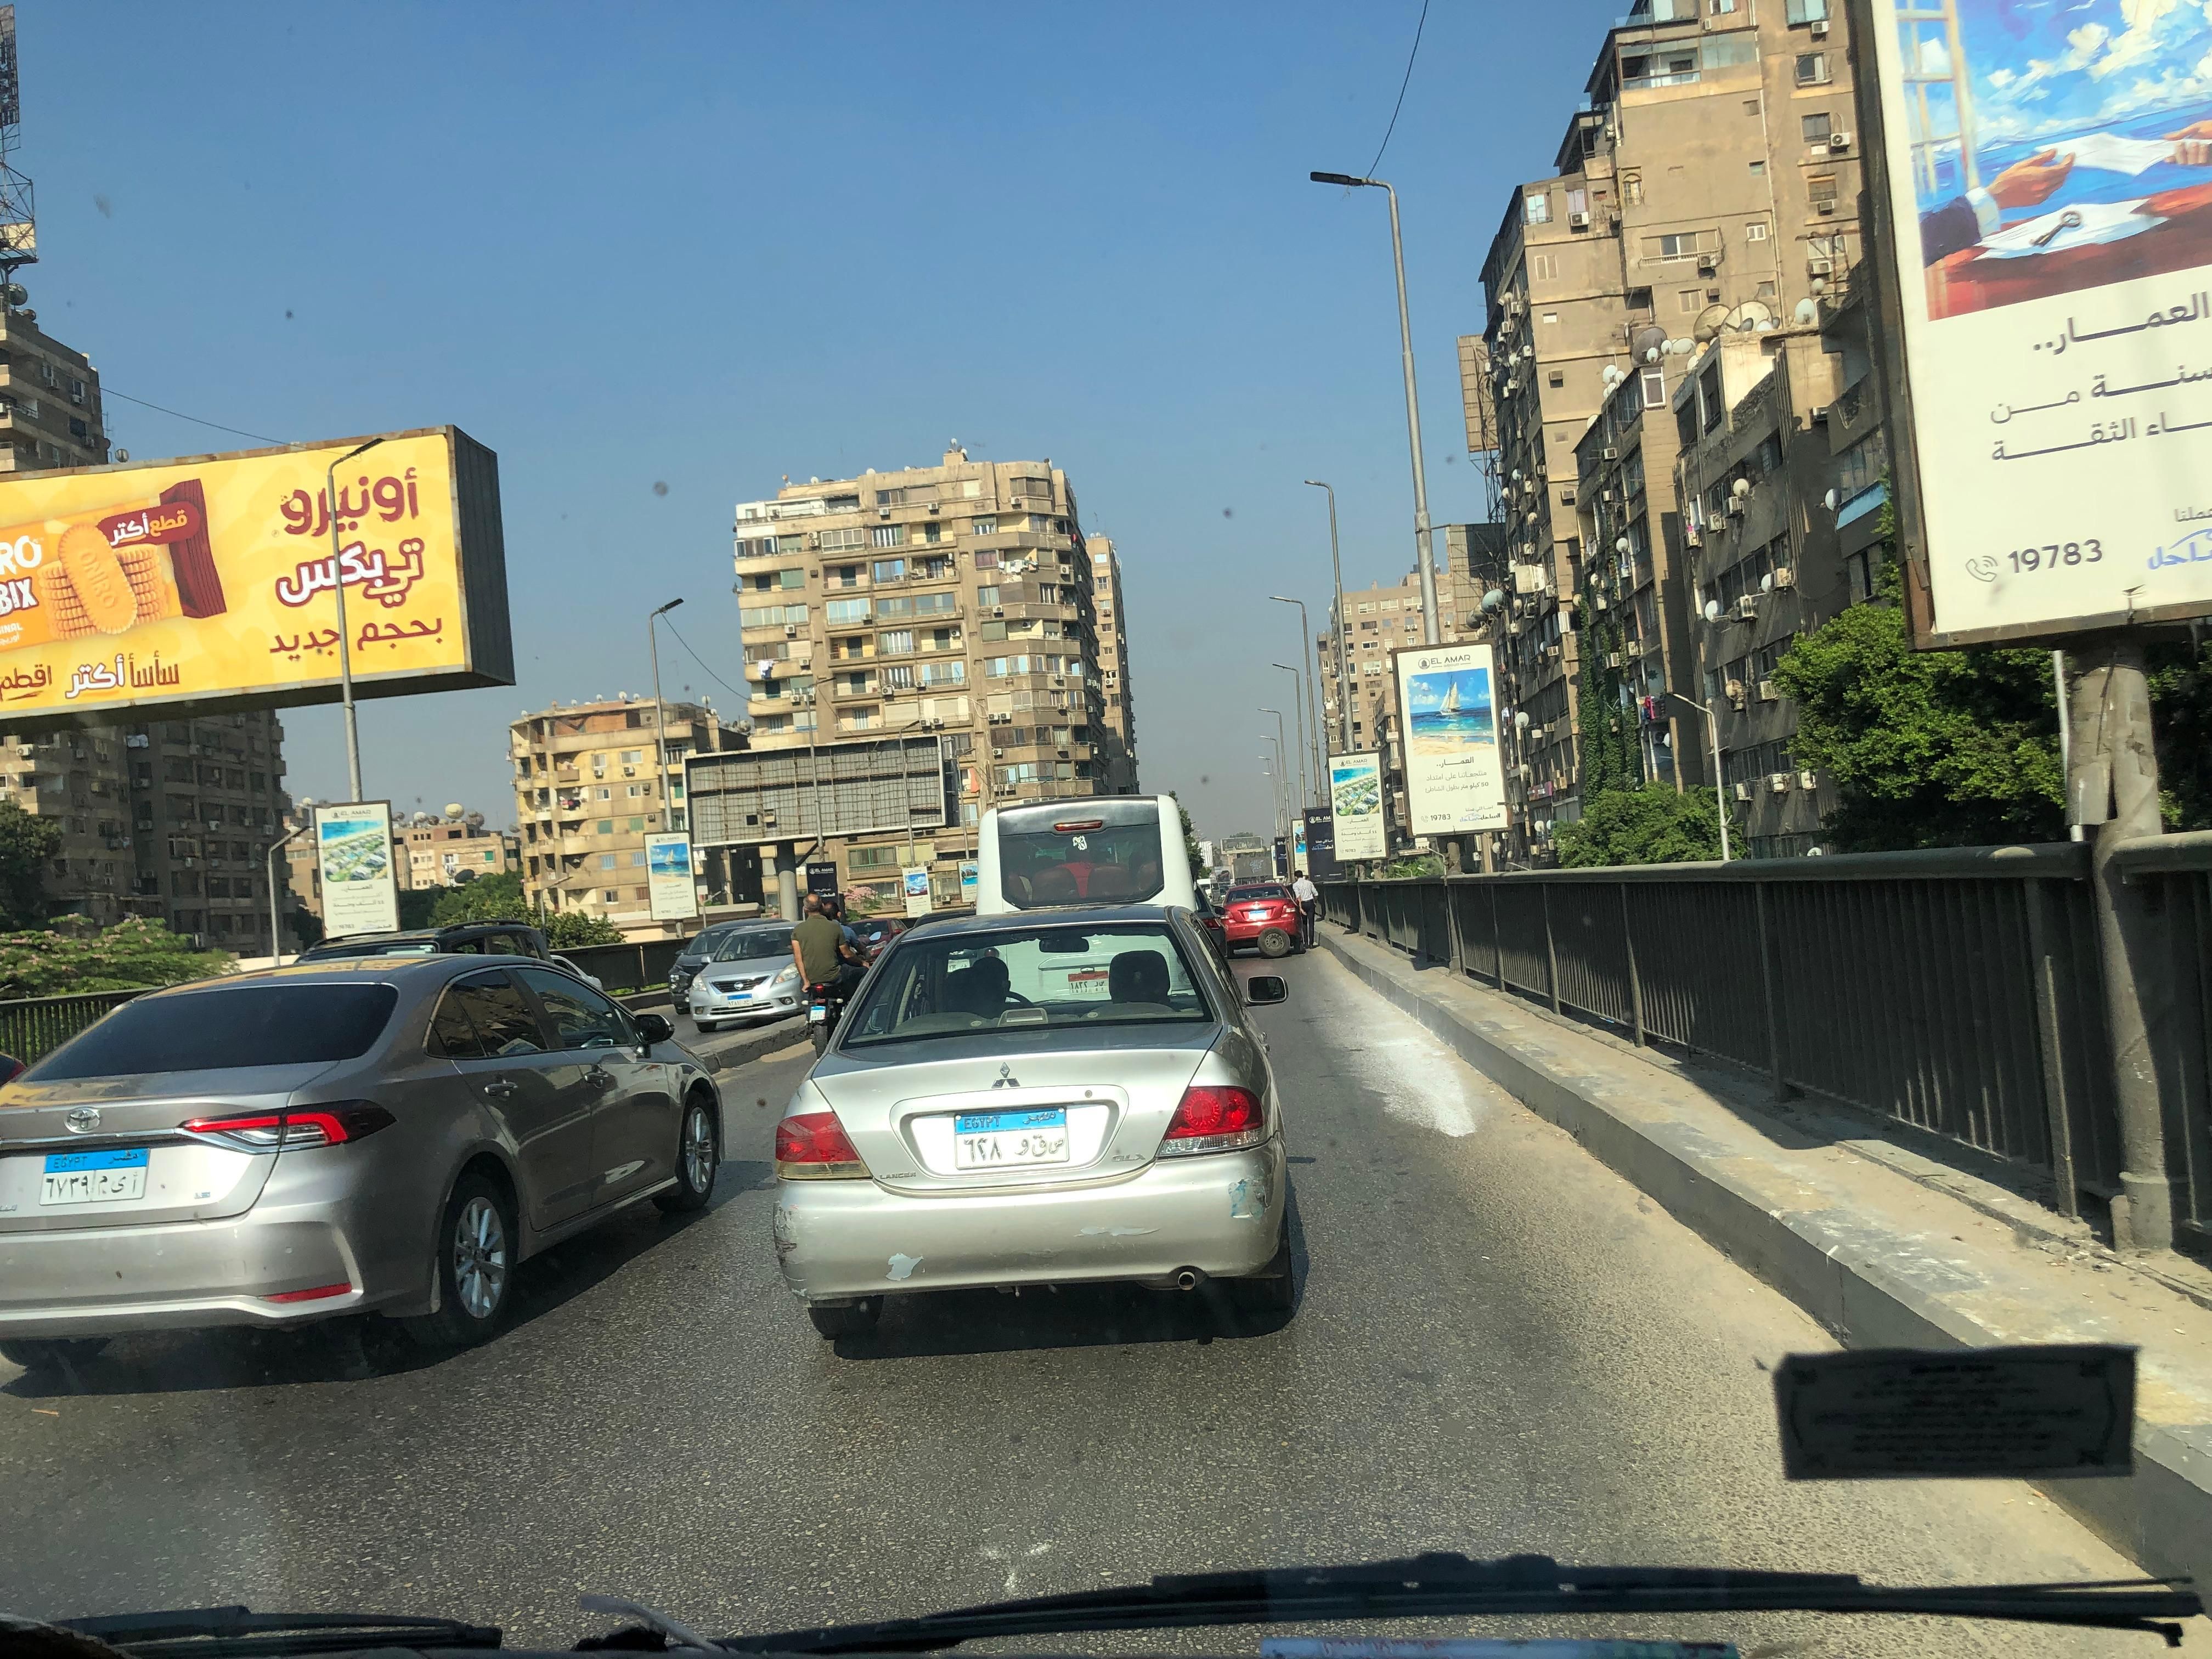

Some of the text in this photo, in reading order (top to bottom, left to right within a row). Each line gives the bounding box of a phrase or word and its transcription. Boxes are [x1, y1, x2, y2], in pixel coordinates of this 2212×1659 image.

[1990, 390, 2080, 424] من
[1991, 416, 2135, 460] الثقة
[110, 509, 188, 546] قطع أكتر
[2007, 539, 2103, 573] 19783
[269, 617, 442, 662] بحجم جديد
[1444, 654, 1471, 664] AMAR
[65, 653, 126, 699] أكتر
[1426, 773, 1444, 781] امتداد
[1445, 772, 1457, 781] على
[1469, 781, 1480, 790] كيلو
[964, 1115, 1001, 1130] EGYPT
[1022, 1111, 1057, 1125] مصر
[53, 1156, 88, 1169] EGYPT
[108, 1150, 139, 1164] مصر
[1112, 1153, 1146, 1163] GLX
[879, 1171, 917, 1180] LANCER
